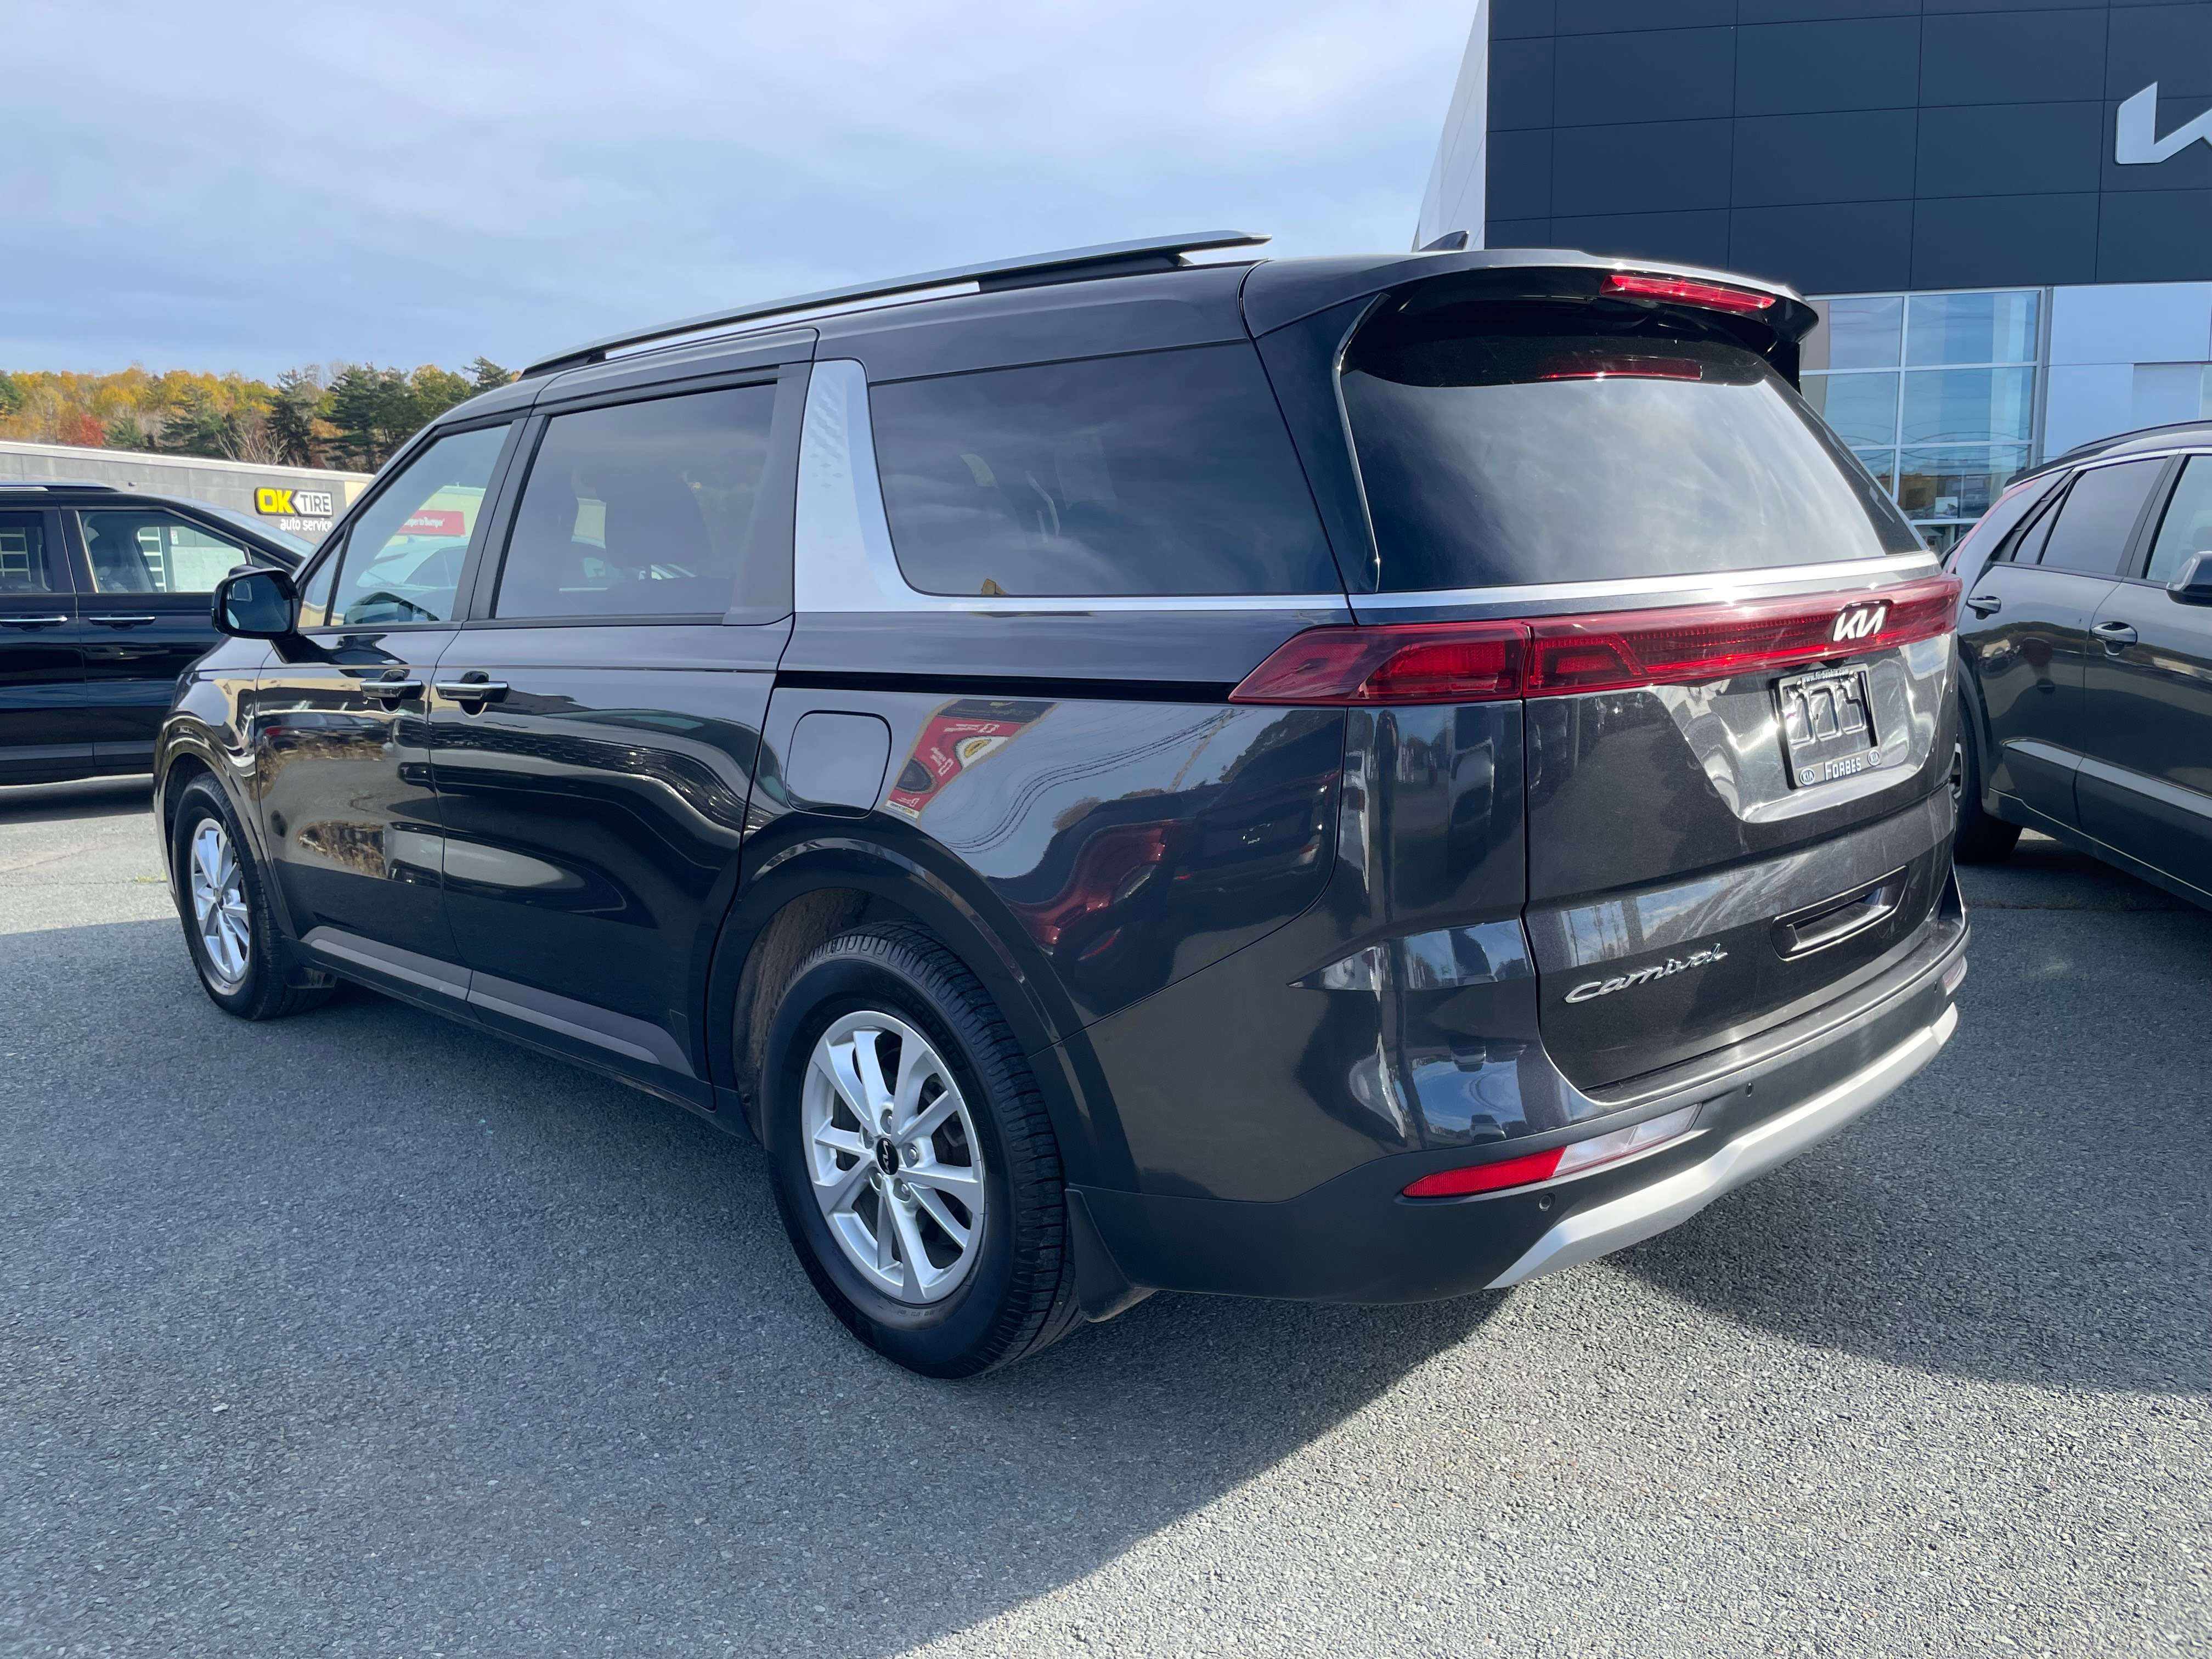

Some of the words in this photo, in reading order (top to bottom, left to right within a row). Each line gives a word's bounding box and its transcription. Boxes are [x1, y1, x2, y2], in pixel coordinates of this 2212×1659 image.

[258, 488, 295, 513] OK
[300, 494, 330, 512] TIRE
[280, 517, 301, 531] auto
[303, 518, 332, 532] service
[1833, 606, 1887, 641] KIA
[1802, 770, 1814, 783] KIA
